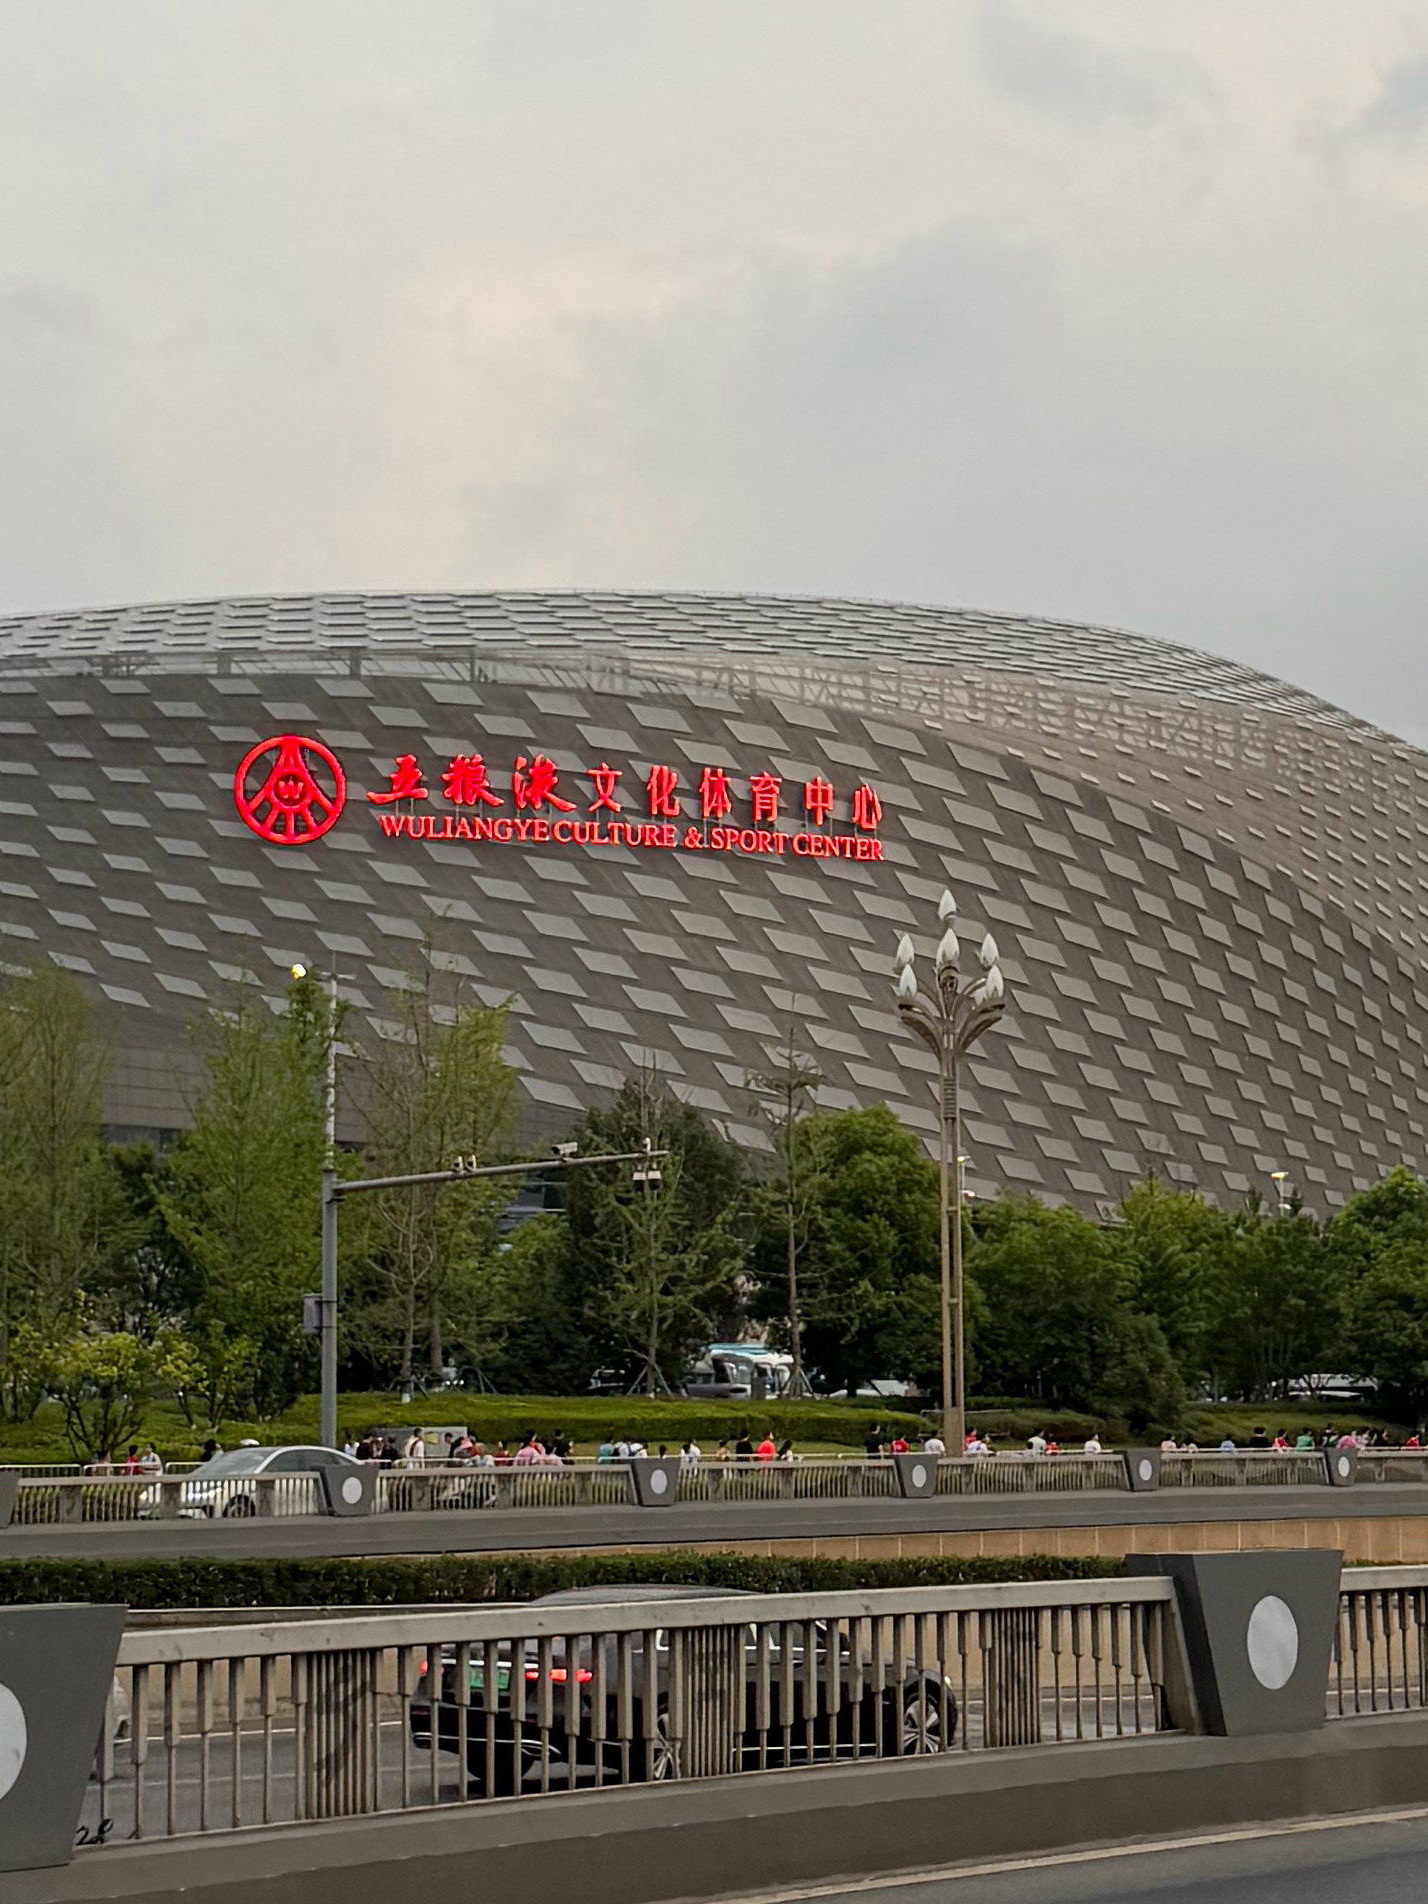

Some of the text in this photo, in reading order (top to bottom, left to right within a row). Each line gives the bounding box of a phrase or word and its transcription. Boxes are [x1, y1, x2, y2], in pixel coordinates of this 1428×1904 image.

[366, 753, 883, 830] 五粮液文化体育中心
[379, 814, 884, 861] WULIANGYE CULTURE & SPORT CENTER
